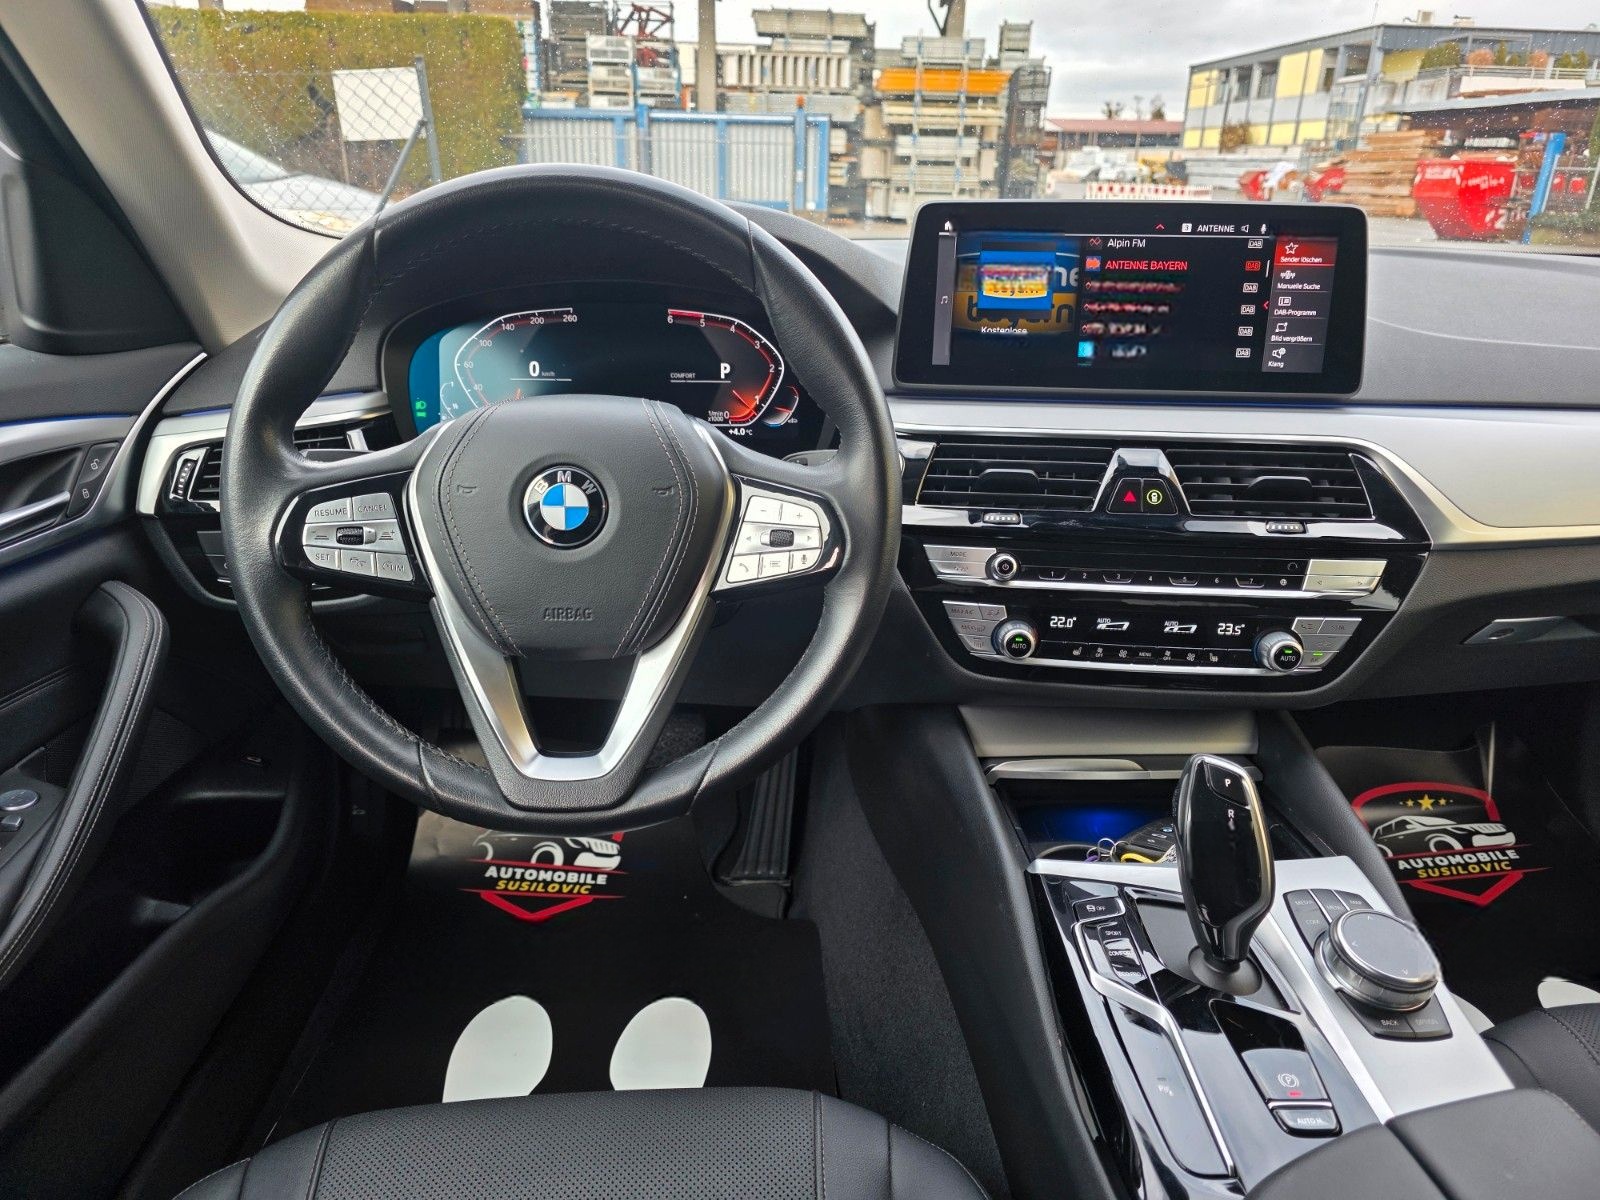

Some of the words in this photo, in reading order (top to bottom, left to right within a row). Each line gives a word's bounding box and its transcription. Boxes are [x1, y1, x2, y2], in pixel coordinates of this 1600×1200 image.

[1108, 239, 1130, 248] Alpin
[1132, 239, 1146, 248] FM
[1105, 261, 1148, 270] ANTENNE
[1150, 261, 1188, 271] BAYERN
[1247, 262, 1260, 270] DAB
[1244, 284, 1257, 292] DAB
[1277, 282, 1302, 290] Manuelle
[1242, 306, 1254, 314] DAB
[562, 314, 578, 322] 260
[668, 315, 674, 324] 6
[700, 320, 706, 328] 5
[730, 325, 736, 333] 4
[1240, 328, 1252, 336] DAB
[754, 341, 760, 349] 3
[1237, 349, 1250, 357] DAB
[528, 360, 540, 376] 0
[720, 362, 730, 379] P
[769, 364, 774, 372] 2
[755, 395, 760, 404] 1
[728, 428, 745, 436] +4.0
[534, 471, 597, 495] BMW
[314, 507, 348, 517] RESUME
[358, 504, 387, 513] CANCEL
[544, 607, 592, 621] AIRBAG
[1225, 779, 1231, 787] P
[1228, 809, 1234, 818] R
[1398, 850, 1520, 870] AUTOMOBILE
[1417, 860, 1512, 879] SUSILOVIC
[484, 866, 608, 885] AUTOMOBILE
[496, 880, 592, 894] SUSILOVIC
